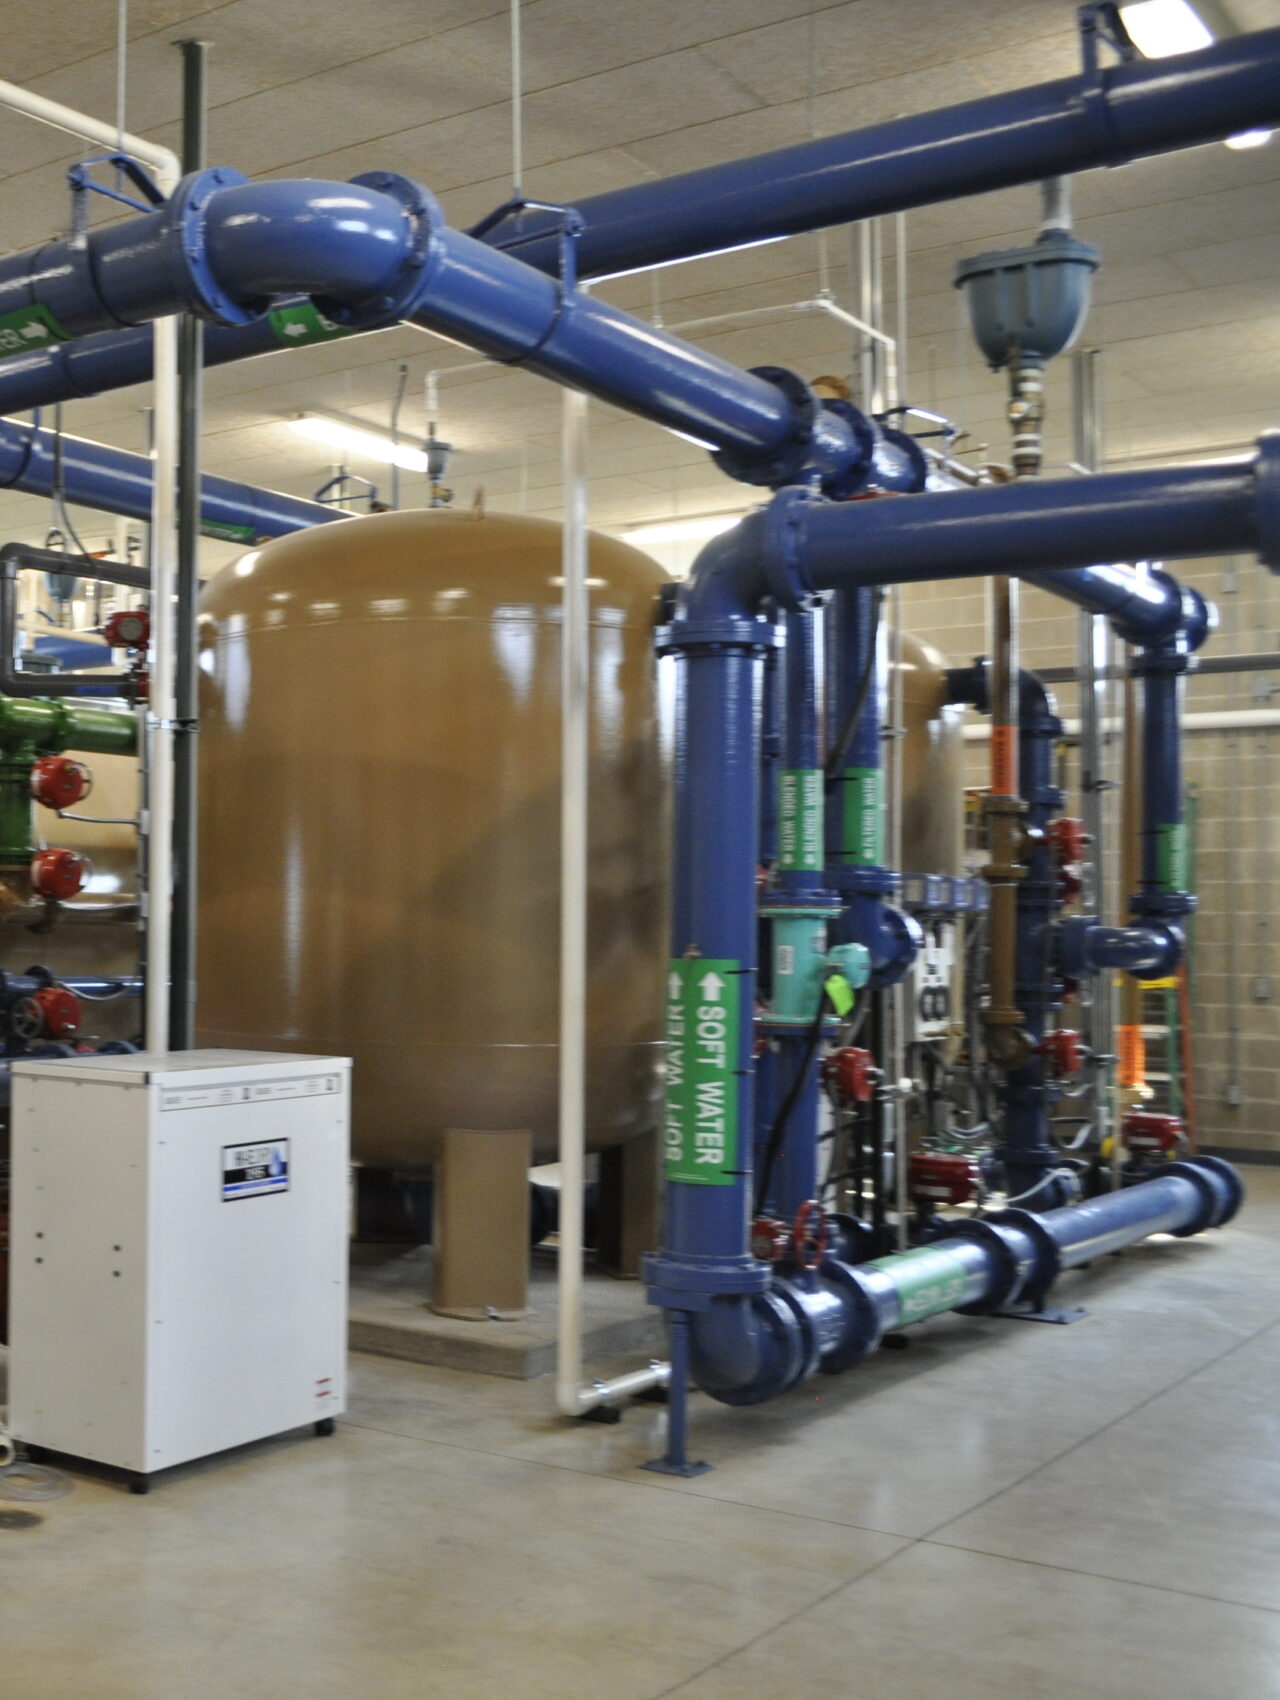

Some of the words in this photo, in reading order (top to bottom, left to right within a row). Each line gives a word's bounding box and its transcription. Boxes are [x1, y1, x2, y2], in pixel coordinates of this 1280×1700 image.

[781, 775, 797, 817] BLENDED
[802, 775, 817, 806] WATER
[863, 778, 876, 805] WATER
[781, 820, 797, 852] WATER
[802, 809, 817, 852] BLENDED
[696, 1005, 726, 1069] SOFT
[695, 1081, 726, 1164] WATER
